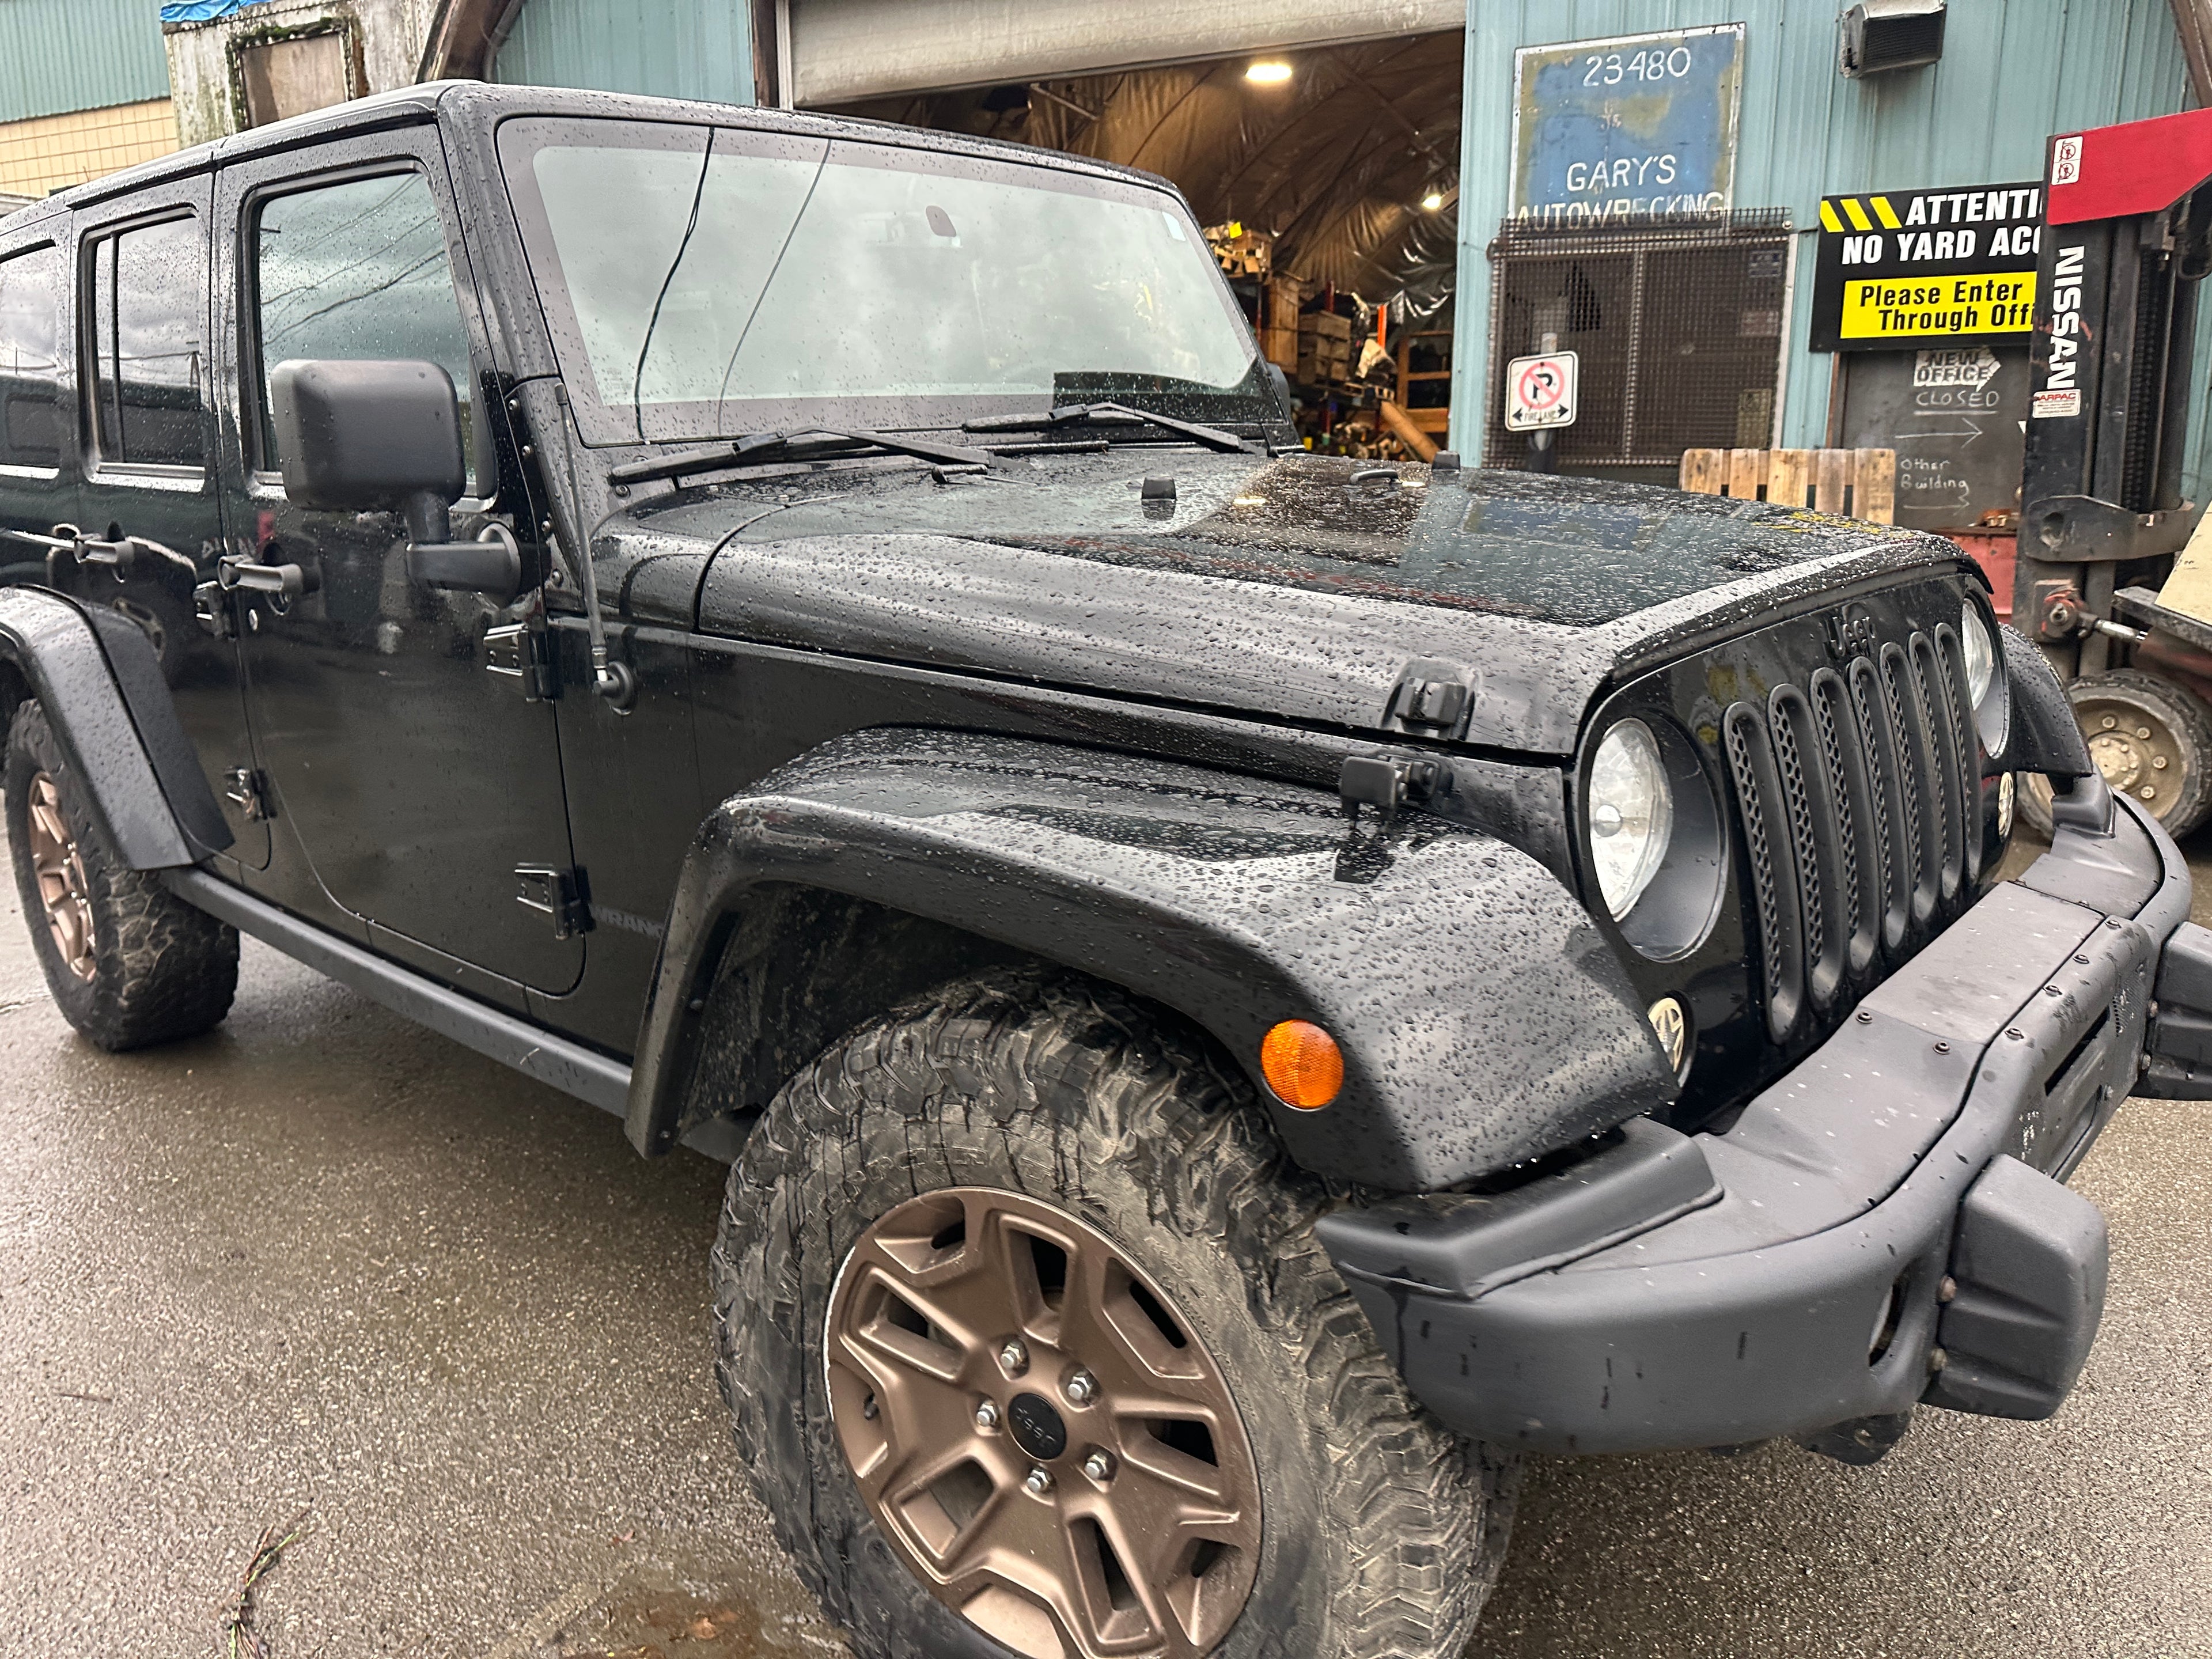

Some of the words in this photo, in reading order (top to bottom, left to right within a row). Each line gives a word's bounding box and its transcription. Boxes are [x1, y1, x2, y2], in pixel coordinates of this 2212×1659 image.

[1583, 47, 1691, 87] 23480
[1566, 154, 1677, 191] GARY'S
[1904, 188, 2043, 226] ATTENTI
[1841, 234, 1883, 265] NO
[1897, 229, 1976, 262] YARD
[1859, 285, 1941, 308] Please
[1953, 281, 2023, 303] Enter
[1878, 305, 1978, 332] Through
[2047, 245, 2085, 389] NISSAN
[1925, 351, 1980, 366] NEW
[1916, 366, 1990, 384] OFFICE
[1916, 390, 2000, 407] CLOSED
[1900, 459, 1950, 471] Other
[1901, 473, 1970, 495] Building
